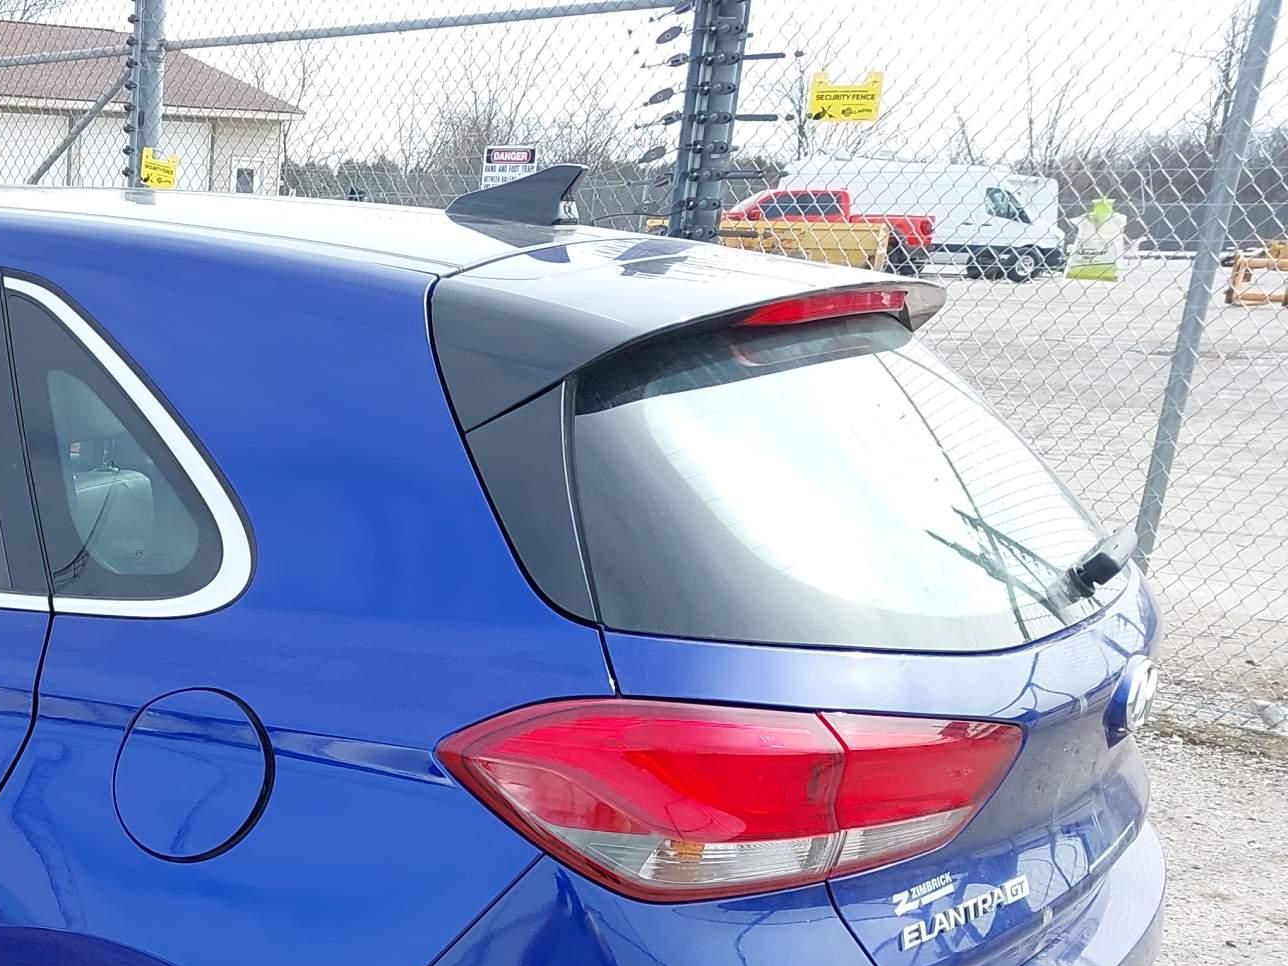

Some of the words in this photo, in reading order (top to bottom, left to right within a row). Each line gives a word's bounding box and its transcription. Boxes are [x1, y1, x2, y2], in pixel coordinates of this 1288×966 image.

[815, 93, 851, 101] SECURITY
[852, 93, 877, 101] FENCE
[493, 151, 529, 161] DANGER
[909, 871, 953, 898] ZIMBRICK
[901, 886, 1005, 951] ELANTRA
